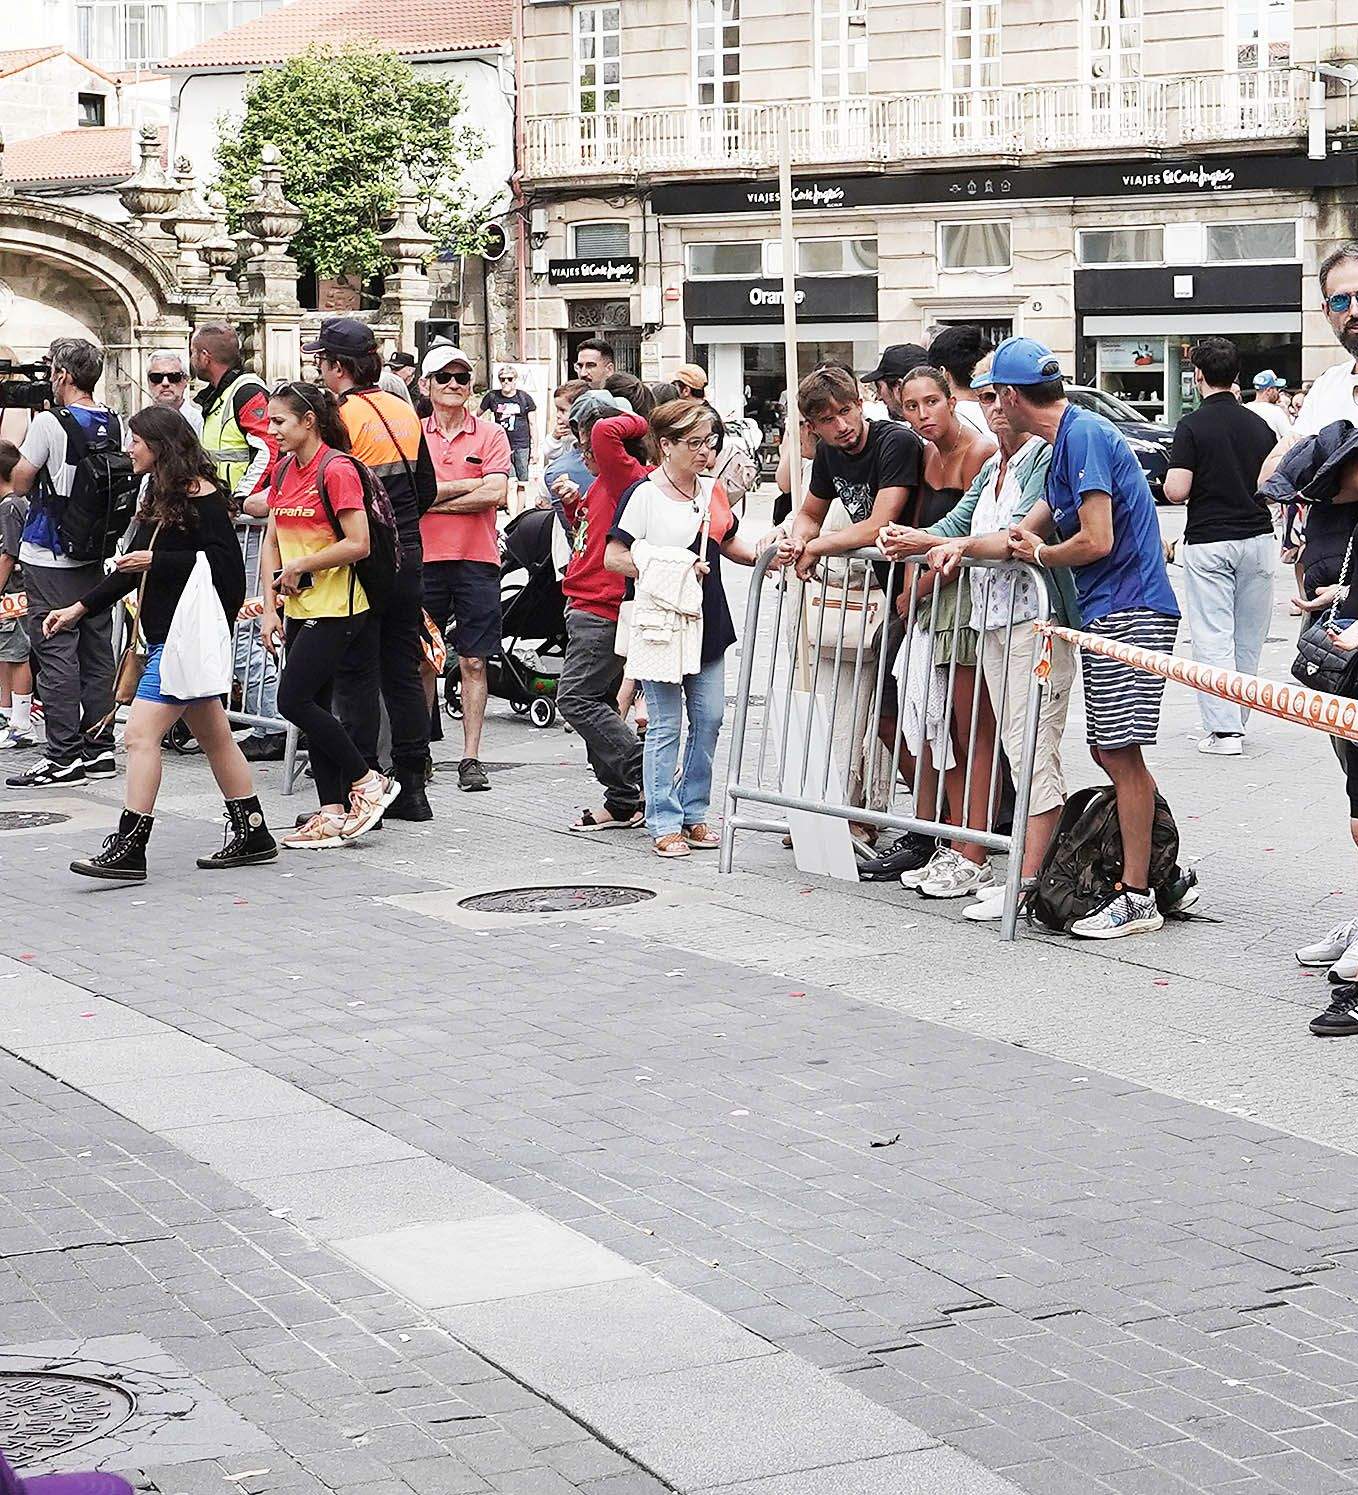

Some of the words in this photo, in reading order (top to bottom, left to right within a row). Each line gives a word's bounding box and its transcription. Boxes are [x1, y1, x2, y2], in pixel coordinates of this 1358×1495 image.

[1122, 174, 1161, 187] VIAJES
[747, 192, 781, 205] VIAJES
[551, 266, 580, 279] VIAJES
[749, 287, 806, 306] Orane
